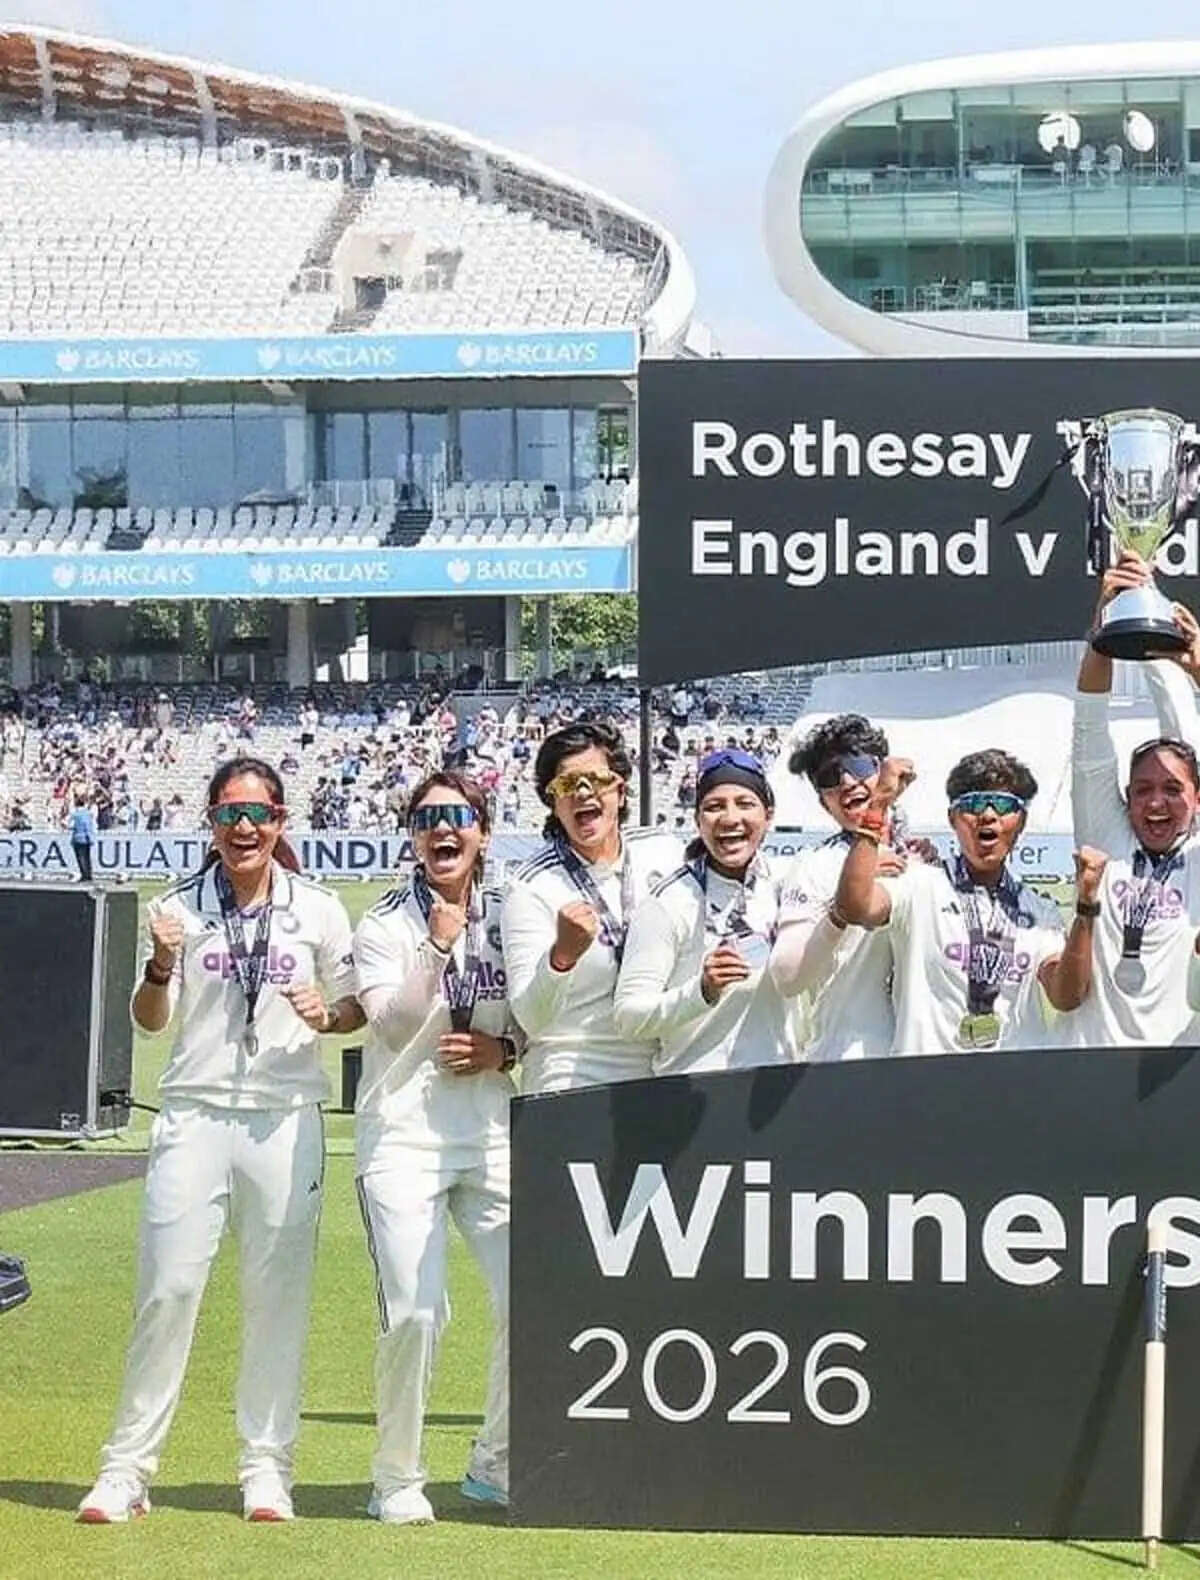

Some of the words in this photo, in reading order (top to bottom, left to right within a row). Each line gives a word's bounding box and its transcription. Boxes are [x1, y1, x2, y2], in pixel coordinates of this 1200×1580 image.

[84, 348, 199, 369] BARCLAYS
[285, 345, 396, 367] BARCLAYS
[485, 342, 597, 364] BARCLAYS
[691, 419, 1032, 488] Rothesay
[691, 517, 989, 586] England
[1015, 532, 1059, 576] v
[80, 563, 195, 586] BARCLAYS
[277, 561, 389, 583] BARCLAYS
[476, 559, 588, 580] BARCLAYS
[303, 840, 418, 869] INDIA
[566, 1327, 872, 1426] 2026
